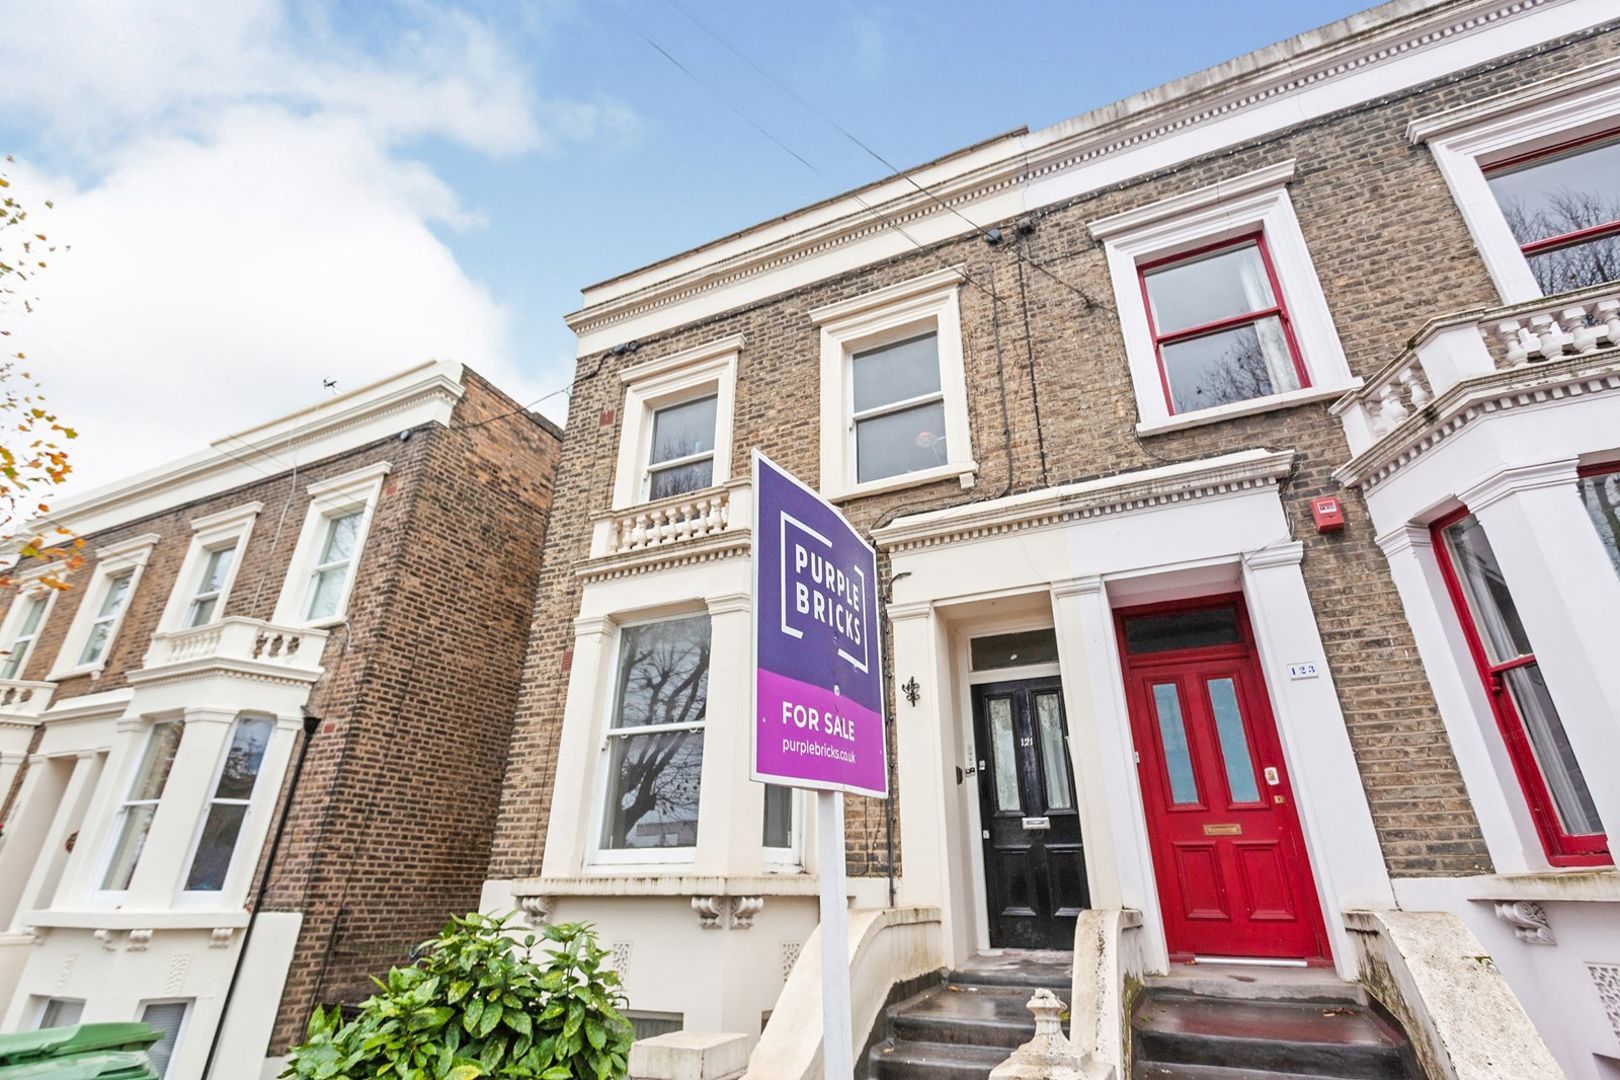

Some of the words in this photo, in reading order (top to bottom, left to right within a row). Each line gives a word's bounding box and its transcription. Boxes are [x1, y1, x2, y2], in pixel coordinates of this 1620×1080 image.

[795, 543, 860, 613] PURPLE
[796, 581, 862, 647] BRICKS
[1291, 665, 1315, 675] 123
[782, 701, 819, 732] FOR
[825, 711, 855, 742] SALE
[782, 738, 856, 765] purplebricks.co.uk
[1021, 737, 1033, 747] 121
